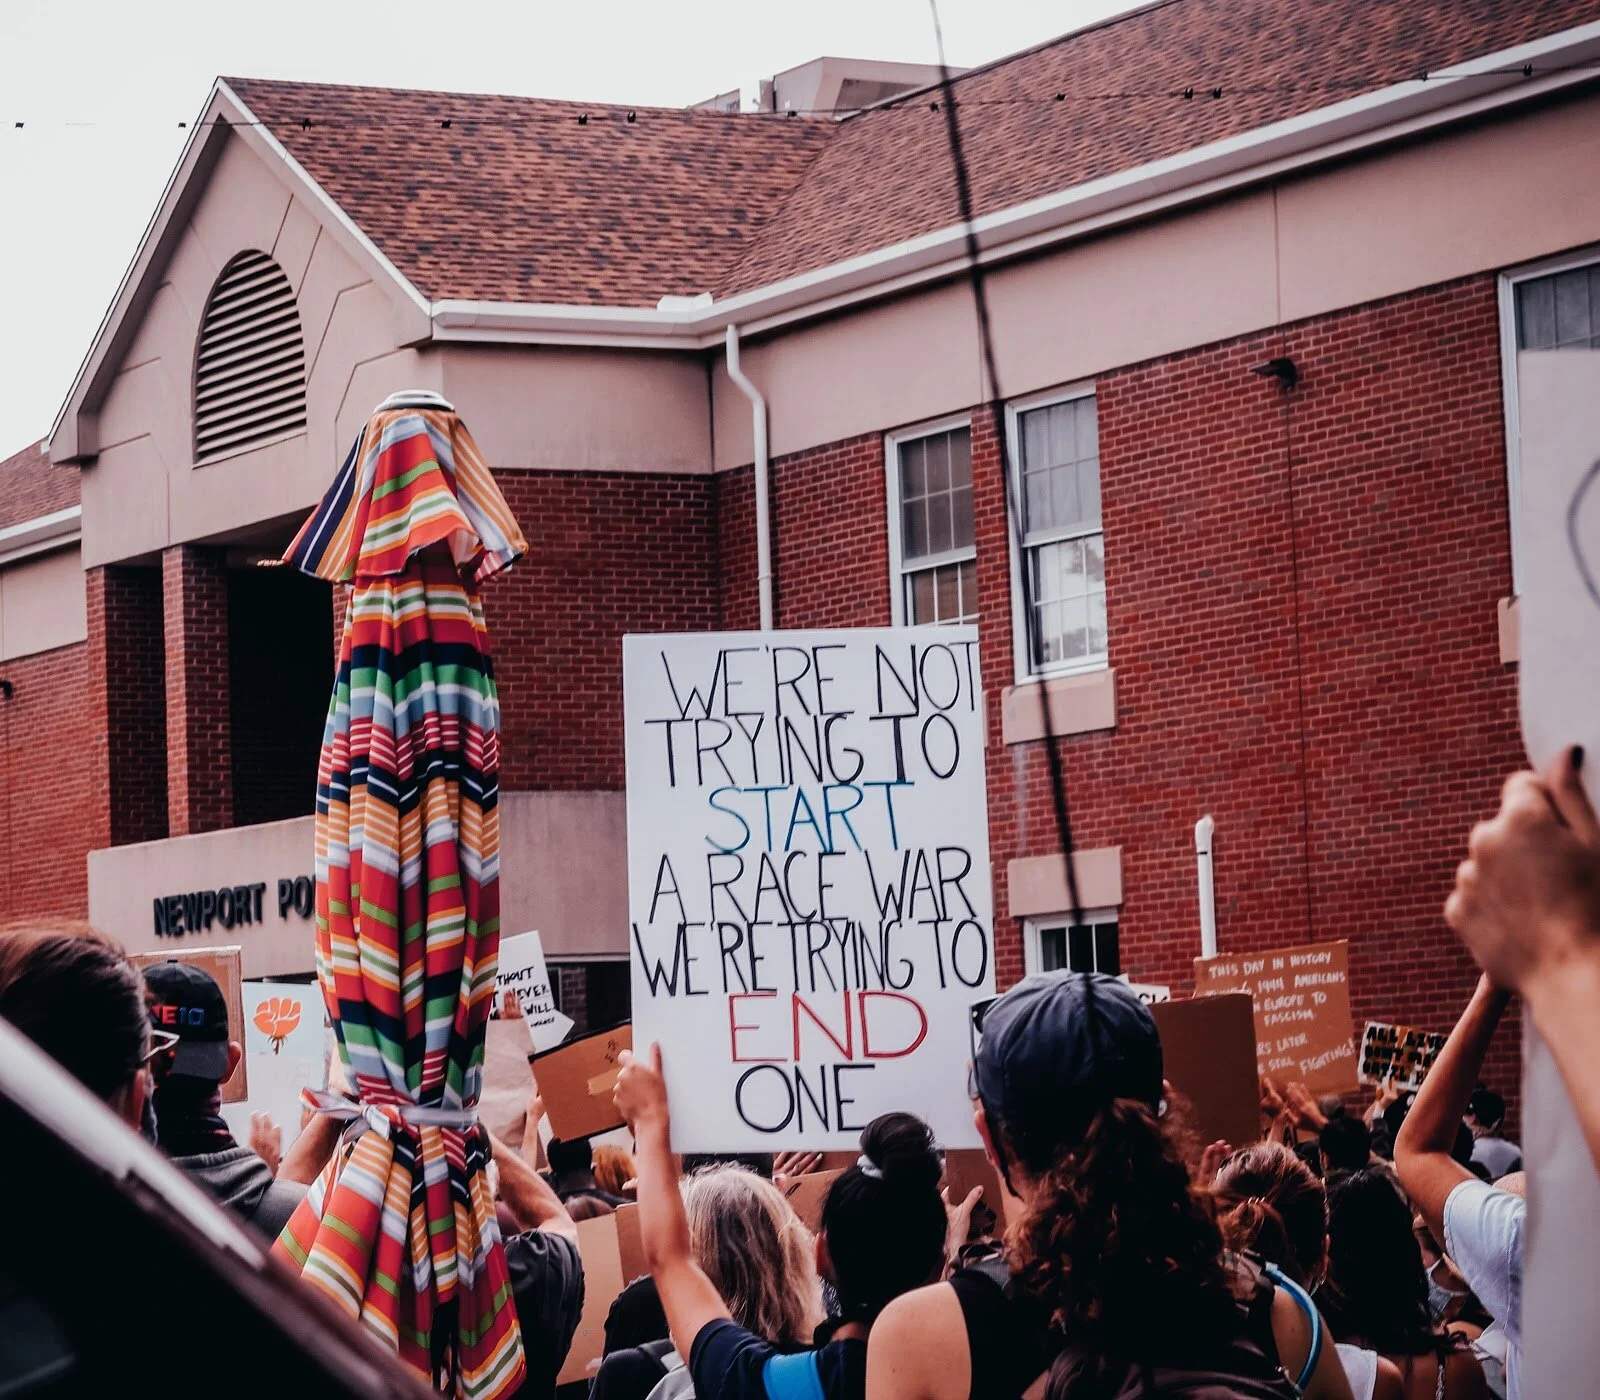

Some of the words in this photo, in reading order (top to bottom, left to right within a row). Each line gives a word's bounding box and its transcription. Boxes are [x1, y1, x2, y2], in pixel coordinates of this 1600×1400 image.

[661, 643, 855, 719] WE'RE
[875, 641, 979, 716] NOT
[644, 713, 865, 787] TRYING
[869, 713, 960, 784] TO
[705, 781, 915, 854] START
[153, 881, 267, 937] NEWPORT
[277, 875, 317, 919] PO
[648, 853, 687, 924] A
[707, 850, 848, 923] RACE
[864, 847, 977, 921] WAR
[778, 919, 914, 992] TRYING
[918, 918, 988, 988] TO
[1209, 963, 1238, 979] THIS
[1243, 959, 1264, 976] DAY
[1272, 957, 1284, 970] IN
[1290, 952, 1331, 968] HISTORY
[1294, 971, 1346, 988] AMERICANS
[728, 989, 928, 1063] END
[1264, 994, 1304, 1011] EUROPE
[1311, 991, 1327, 1006] TO
[1268, 1057, 1296, 1071] STILL
[1277, 1033, 1308, 1052] LATER
[735, 1063, 875, 1133] ONE
